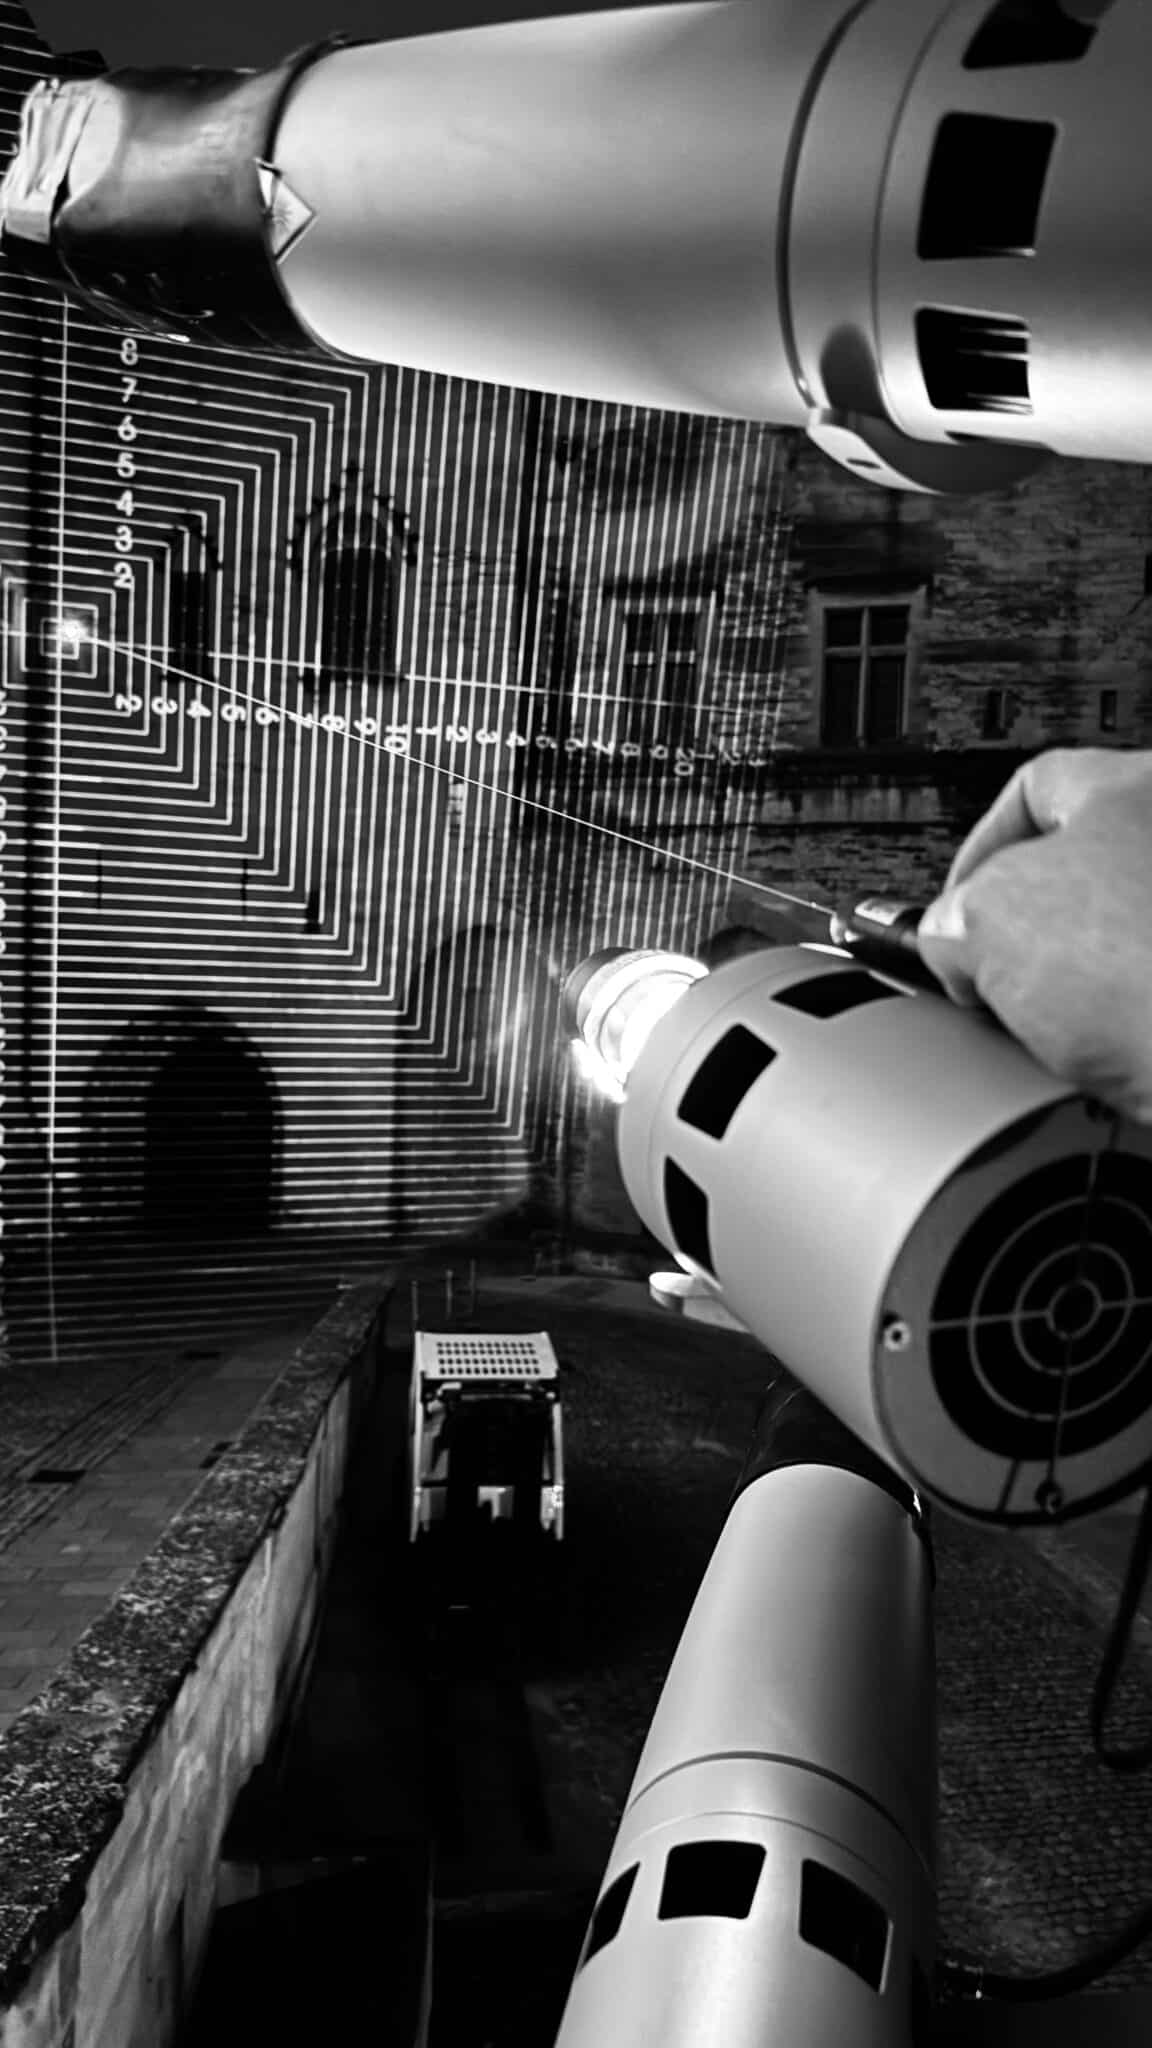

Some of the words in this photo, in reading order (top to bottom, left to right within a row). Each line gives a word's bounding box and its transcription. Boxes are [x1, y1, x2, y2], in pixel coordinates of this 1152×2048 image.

[121, 338, 138, 365] 8
[121, 376, 137, 403] 7
[118, 415, 137, 441] 6
[117, 452, 136, 478] 5
[116, 490, 133, 517] 4
[115, 527, 132, 552] 3
[114, 562, 135, 589] 2
[115, 693, 142, 712] 2
[151, 696, 178, 715] 3
[186, 700, 212, 719] 4
[221, 704, 246, 722] 5
[255, 707, 280, 725] 6
[321, 714, 345, 731] 8
[353, 717, 377, 735] 9
[384, 724, 409, 754] 10
[445, 725, 469, 742] 2
[475, 729, 499, 744] 3
